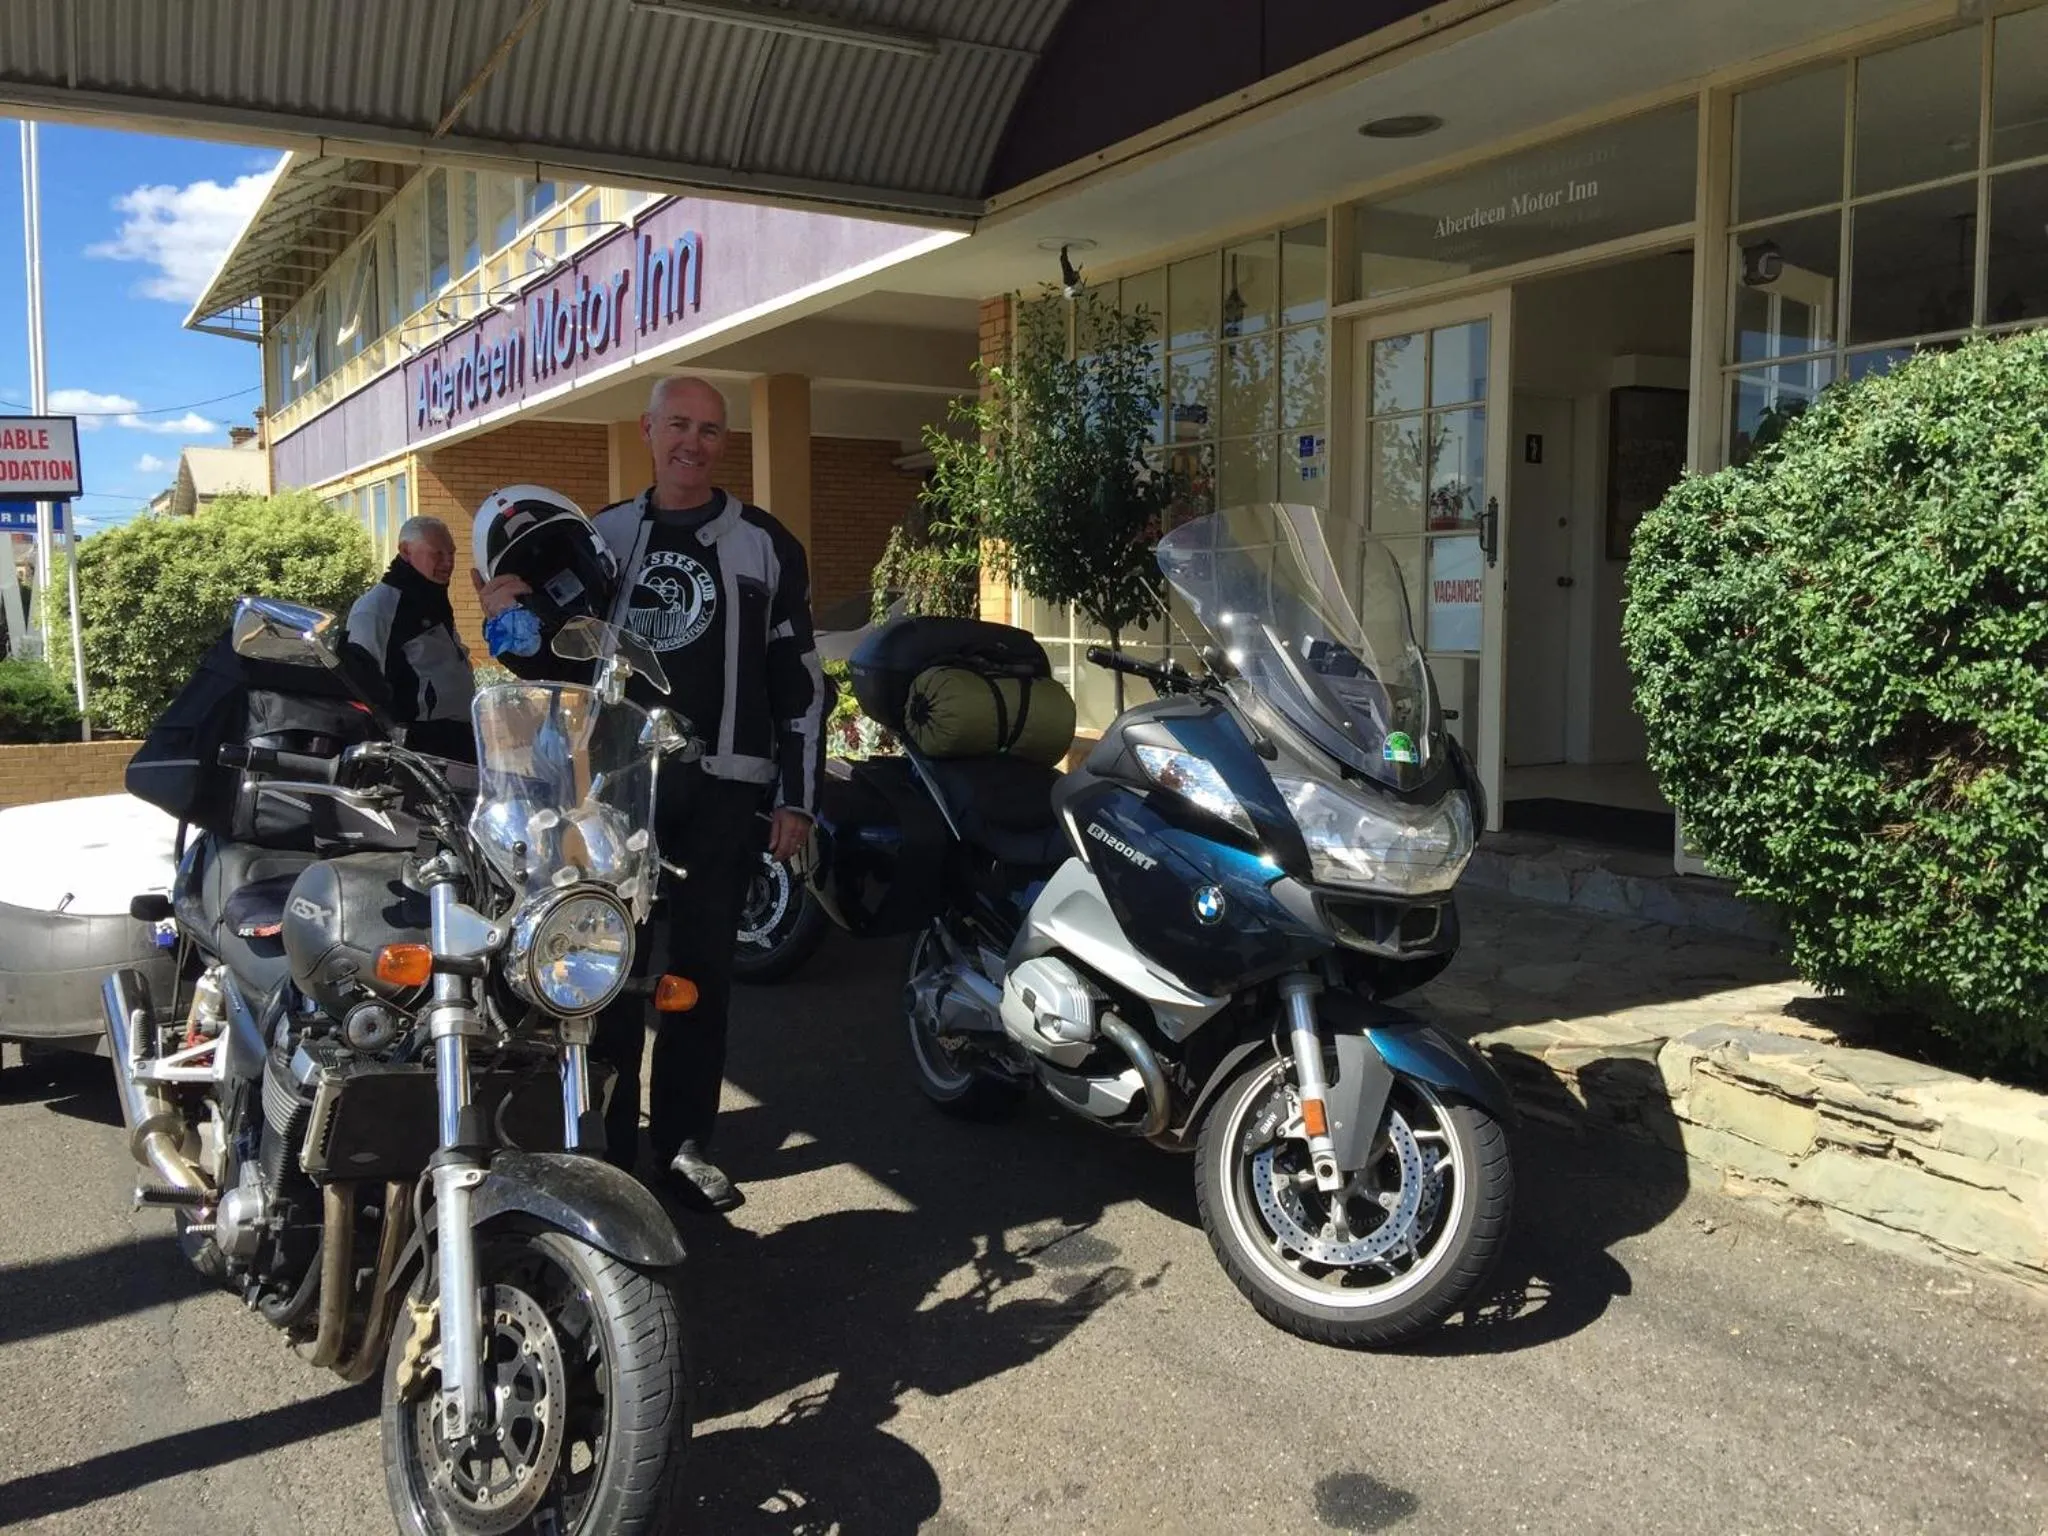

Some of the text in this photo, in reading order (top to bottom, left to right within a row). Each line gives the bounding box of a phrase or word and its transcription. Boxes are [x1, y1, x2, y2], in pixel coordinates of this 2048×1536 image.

[1432, 206, 1505, 240] Aberdeen
[1511, 188, 1563, 218] Motor
[1566, 179, 1598, 203] Inn
[416, 230, 703, 429] Aberdeen Motor Inn
[0, 429, 49, 450] ABLE
[697, 572, 715, 601] CLUB
[1260, 1111, 1277, 1135] BMW
